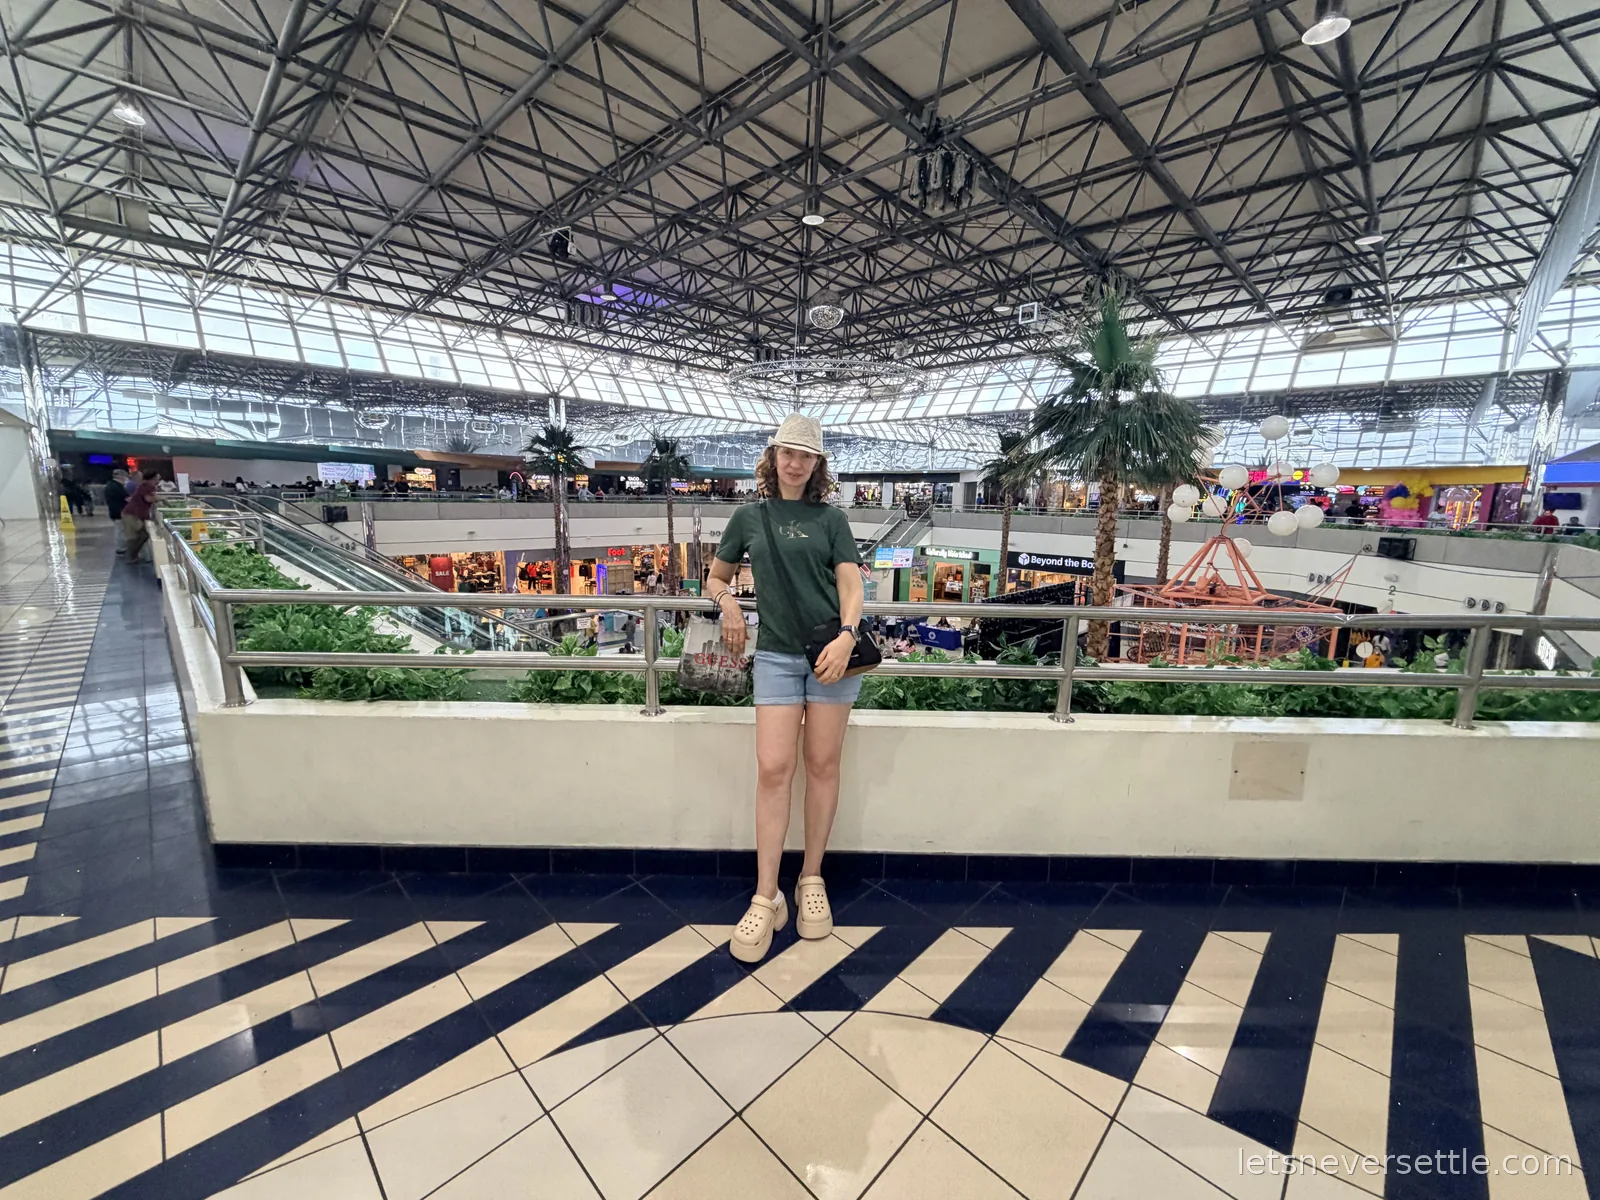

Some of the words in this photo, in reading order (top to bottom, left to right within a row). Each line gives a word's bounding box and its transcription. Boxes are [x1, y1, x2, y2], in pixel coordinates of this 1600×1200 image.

[1031, 555, 1063, 566] Beyond
[1064, 558, 1080, 568] the
[1388, 585, 1397, 596] 2
[693, 652, 748, 671] GUESS
